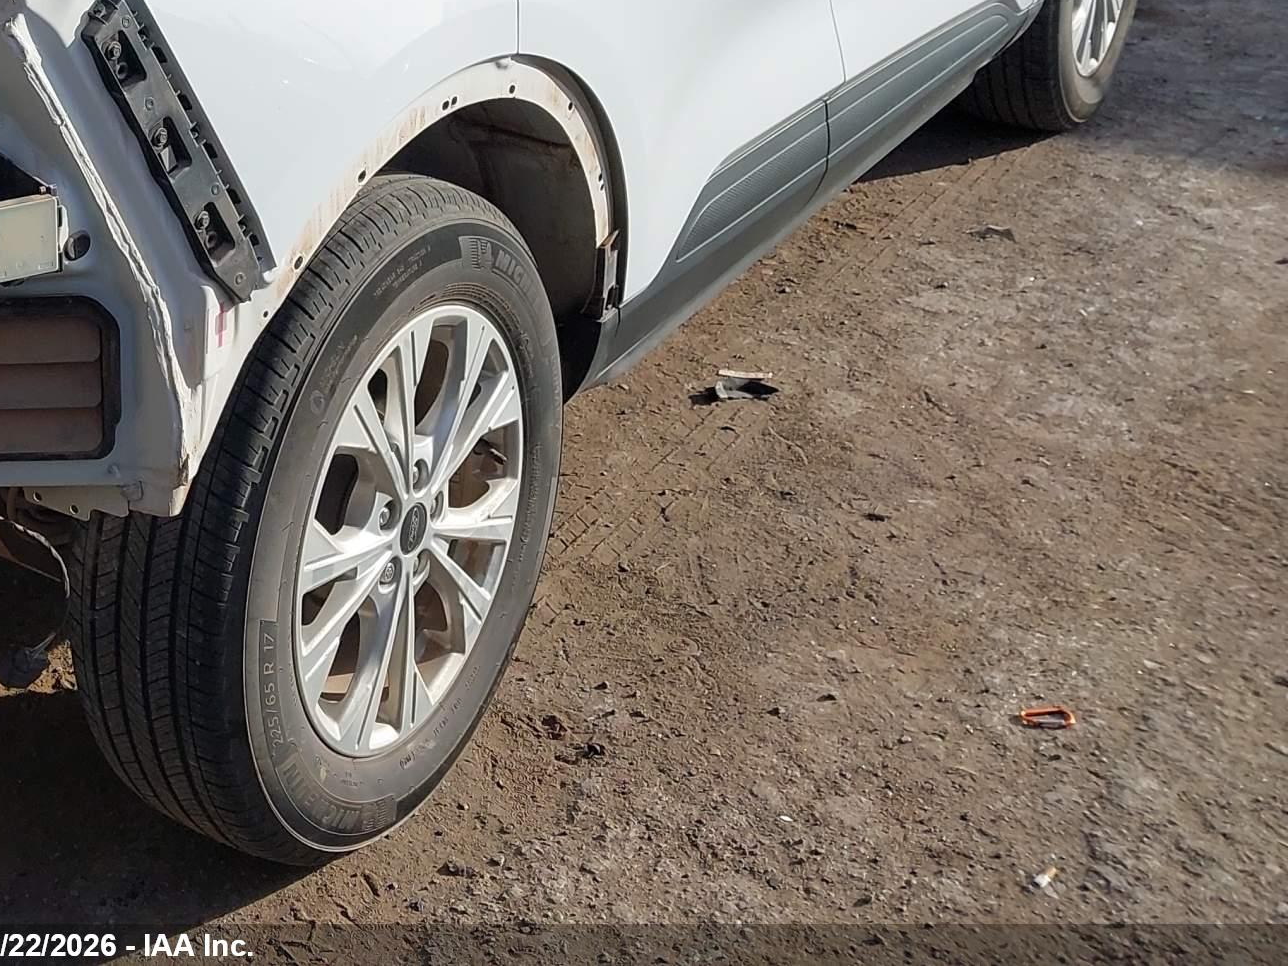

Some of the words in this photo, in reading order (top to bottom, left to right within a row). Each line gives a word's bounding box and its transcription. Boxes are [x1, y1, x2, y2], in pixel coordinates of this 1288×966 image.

[263, 633, 275, 650] 17
[263, 663, 275, 675] R
[264, 682, 284, 749] 225/65
